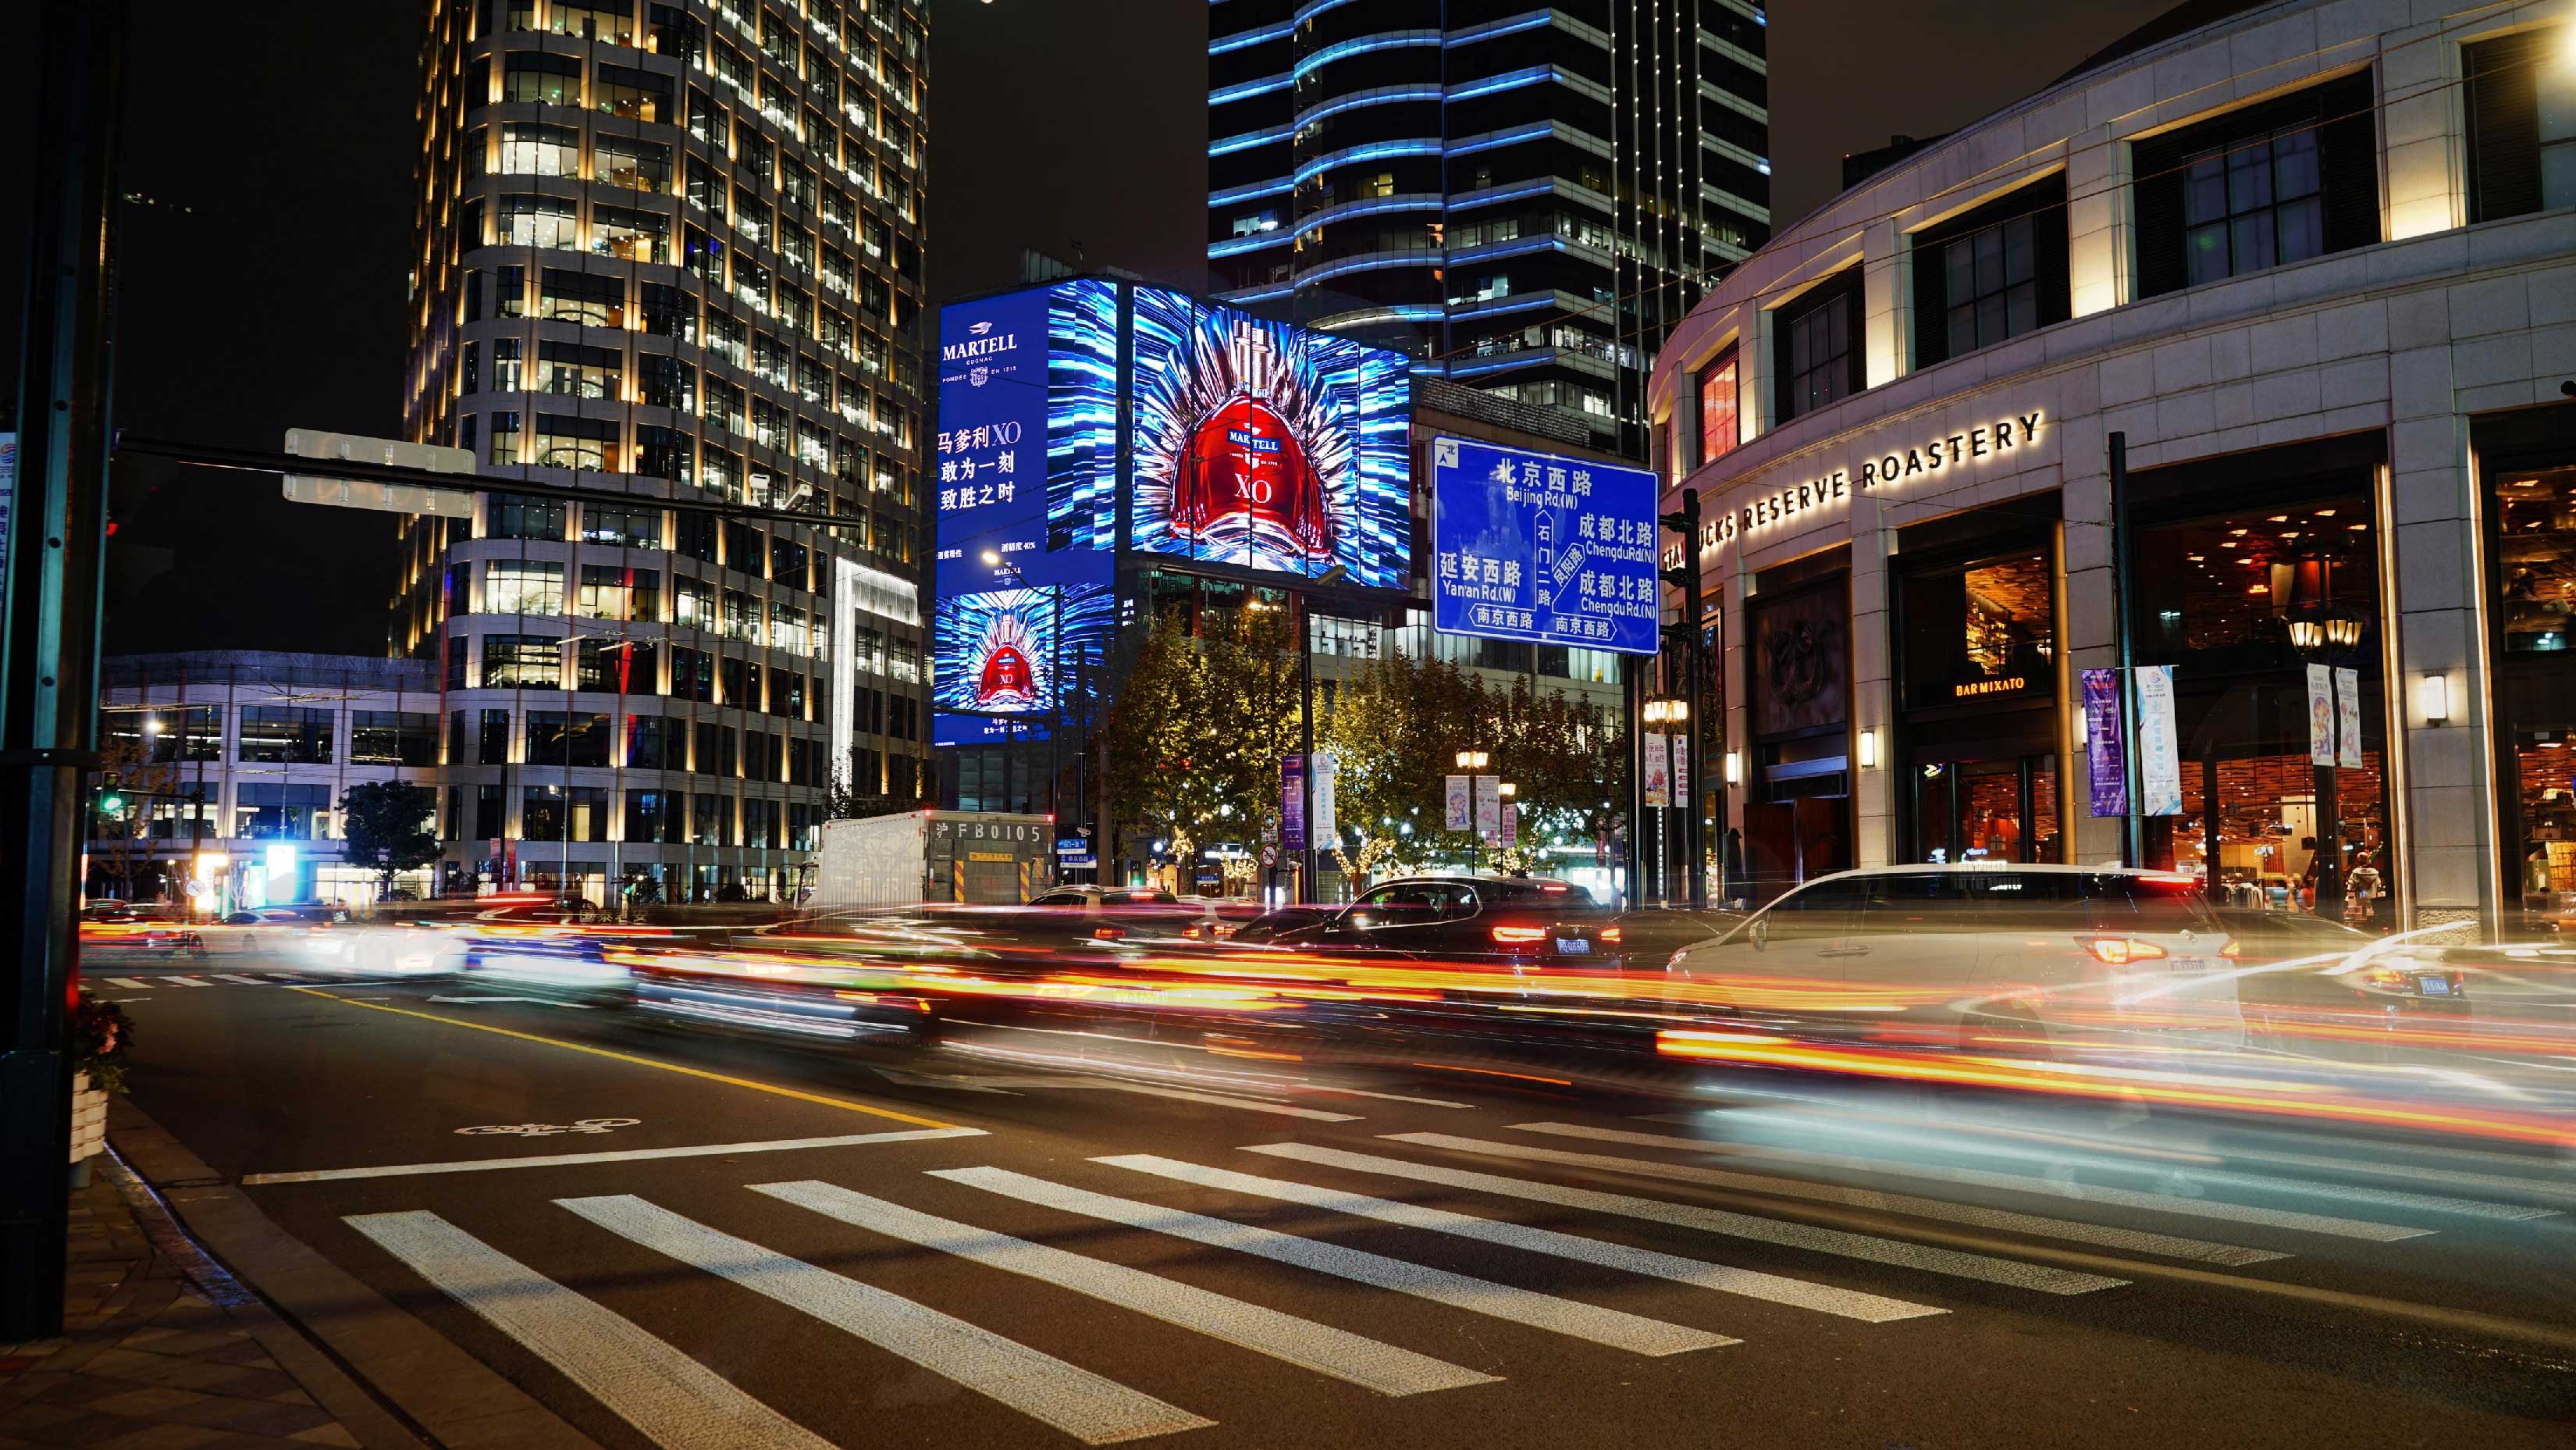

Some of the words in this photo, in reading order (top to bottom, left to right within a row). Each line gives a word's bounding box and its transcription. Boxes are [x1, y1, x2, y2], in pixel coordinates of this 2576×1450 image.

[943, 334, 1017, 361] MARTELL
[966, 356, 992, 365] COGNAC
[938, 421, 1022, 454] 马爹利XO
[1229, 431, 1278, 451] MARTELL
[1446, 444, 1456, 455] 北
[941, 450, 1015, 483] 敢为一刻
[1496, 458, 1592, 497] 北京西路
[940, 481, 1016, 511] 致胜之时
[1234, 472, 1272, 504] XO
[1507, 486, 1542, 508] Beijing
[1545, 493, 1578, 510] Rd.(W)
[1662, 515, 1733, 570] STAUCKS
[1743, 472, 1845, 531] RESERVE
[1862, 413, 2041, 489] ROASTERY
[1579, 512, 1653, 547] 成都北路
[1440, 552, 1521, 587] 延安西路
[1538, 525, 1551, 607] 石门二路
[1553, 547, 1584, 587] 凤阳路
[1443, 580, 1479, 599] Yan'an
[1482, 584, 1516, 603] Rd.(W)
[1579, 570, 1654, 604] 成都北路
[1477, 607, 1533, 629] 南京西路
[1582, 597, 1626, 618] Chengdu
[1556, 617, 1610, 638] 南京西路
[1000, 674, 1013, 684] XO
[1957, 683, 1977, 696] BAR
[1980, 677, 2024, 693] MIXATO
